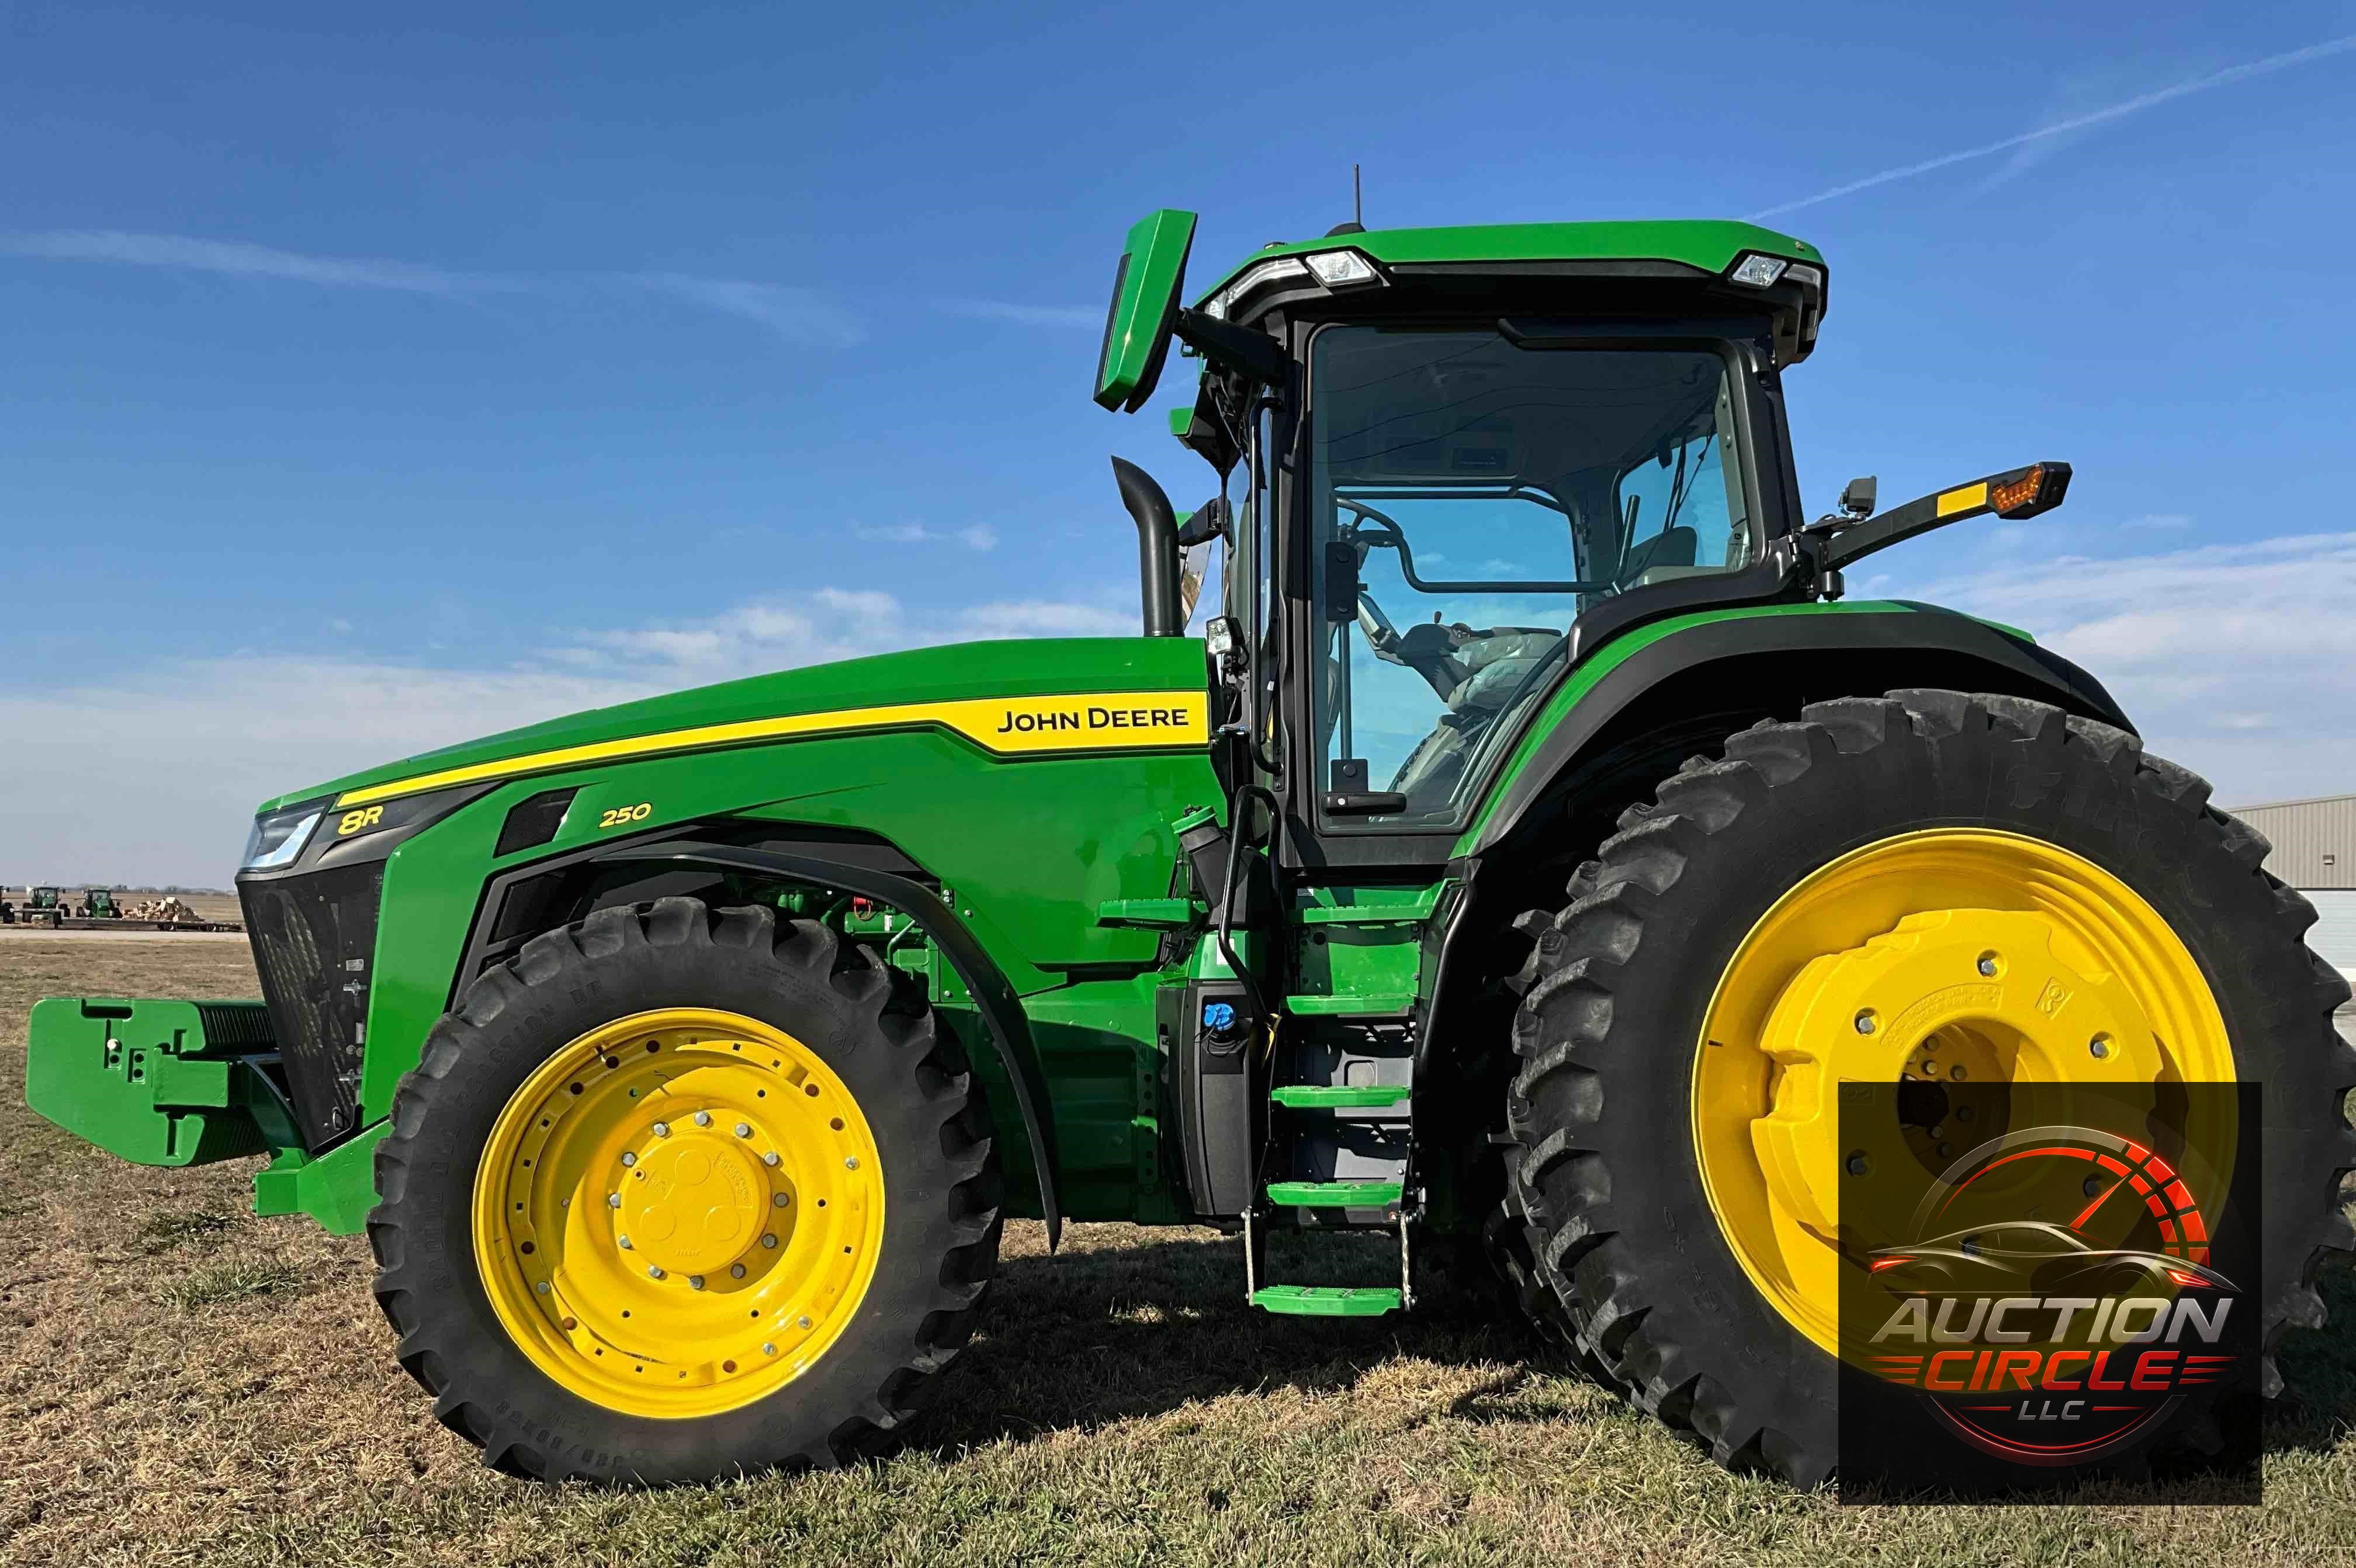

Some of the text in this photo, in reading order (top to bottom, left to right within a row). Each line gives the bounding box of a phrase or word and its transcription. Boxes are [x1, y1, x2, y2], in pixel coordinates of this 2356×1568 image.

[997, 707, 1190, 733] JOHN DEERE
[337, 805, 384, 835] 8R
[598, 802, 652, 828] 250
